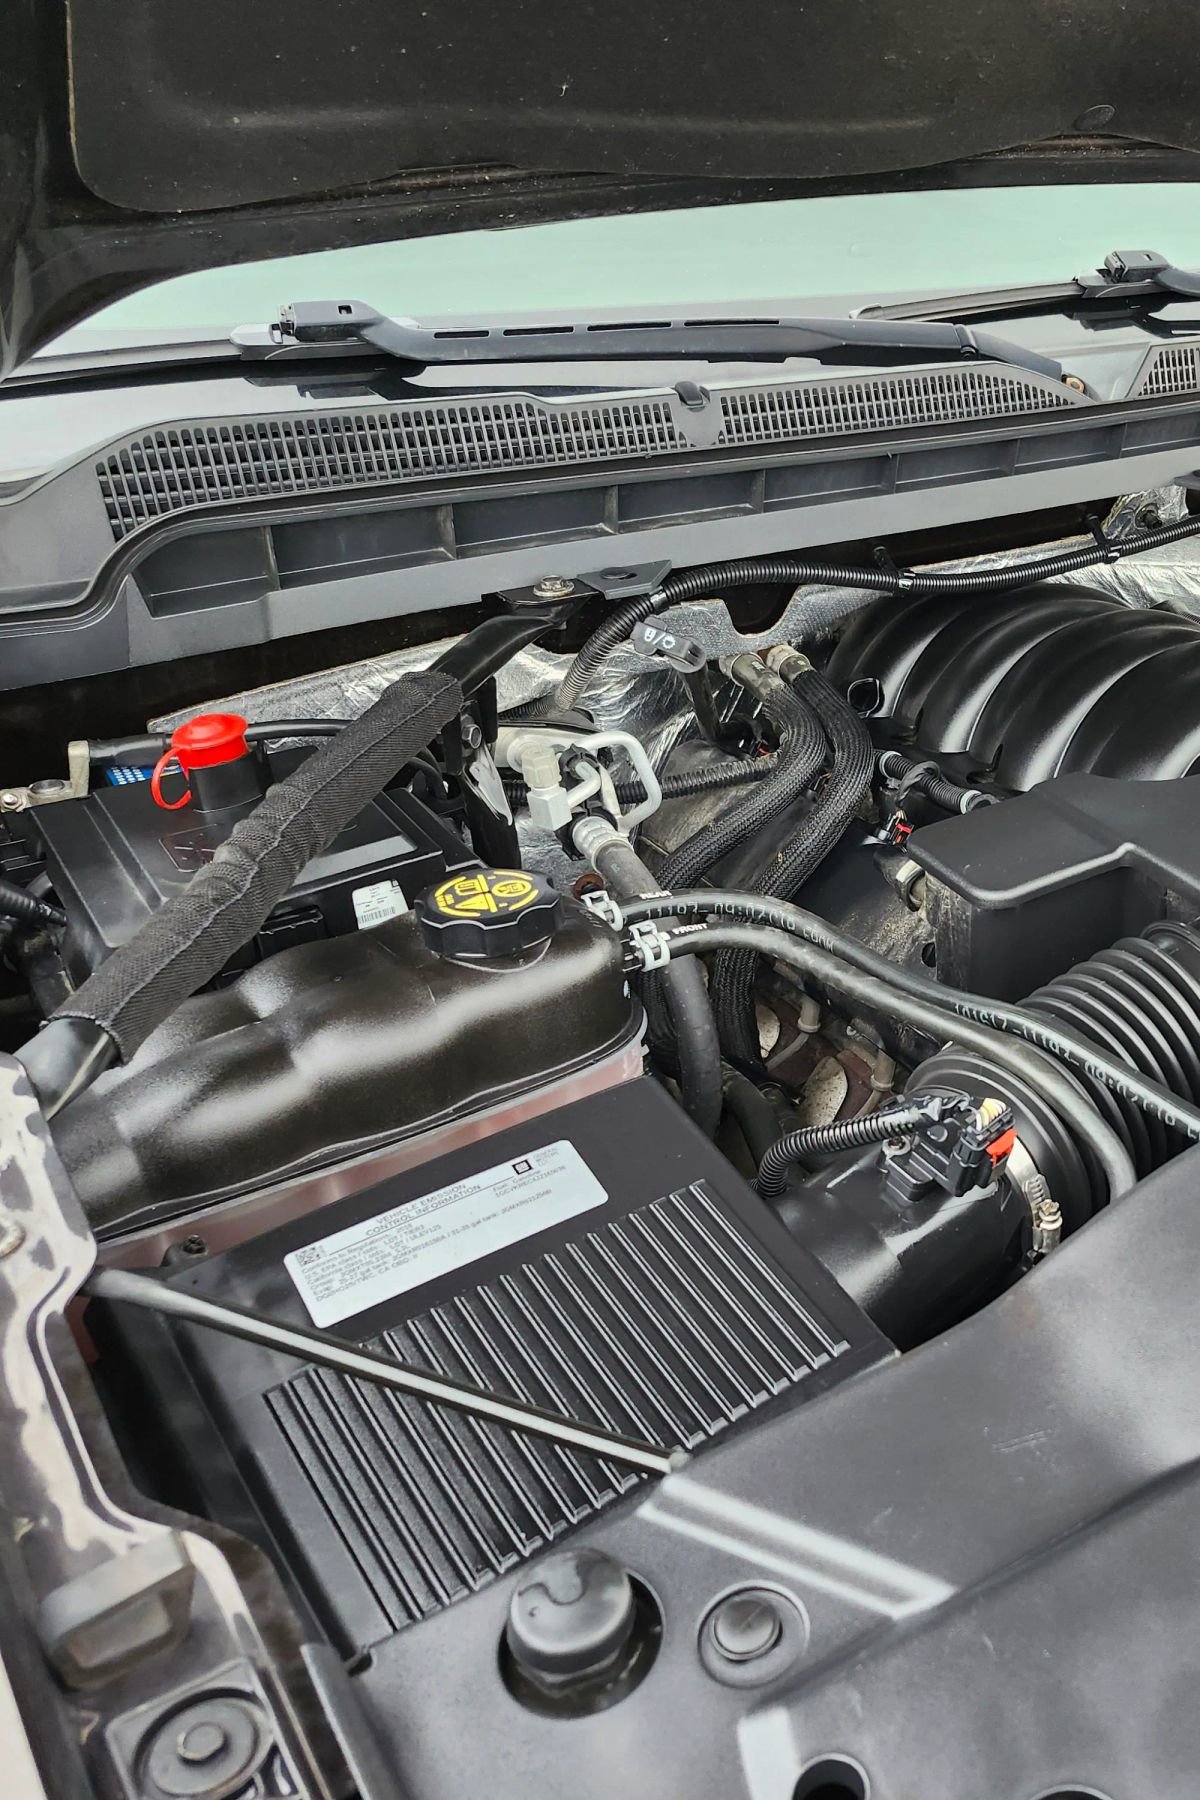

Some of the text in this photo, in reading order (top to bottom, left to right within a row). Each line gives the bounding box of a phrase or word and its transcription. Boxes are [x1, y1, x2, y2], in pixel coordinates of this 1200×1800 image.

[672, 923, 708, 935] FRONT
[364, 1183, 482, 1237] CONTROL INFORMATION
[374, 1182, 467, 1225] VEHICLE EMISSION
